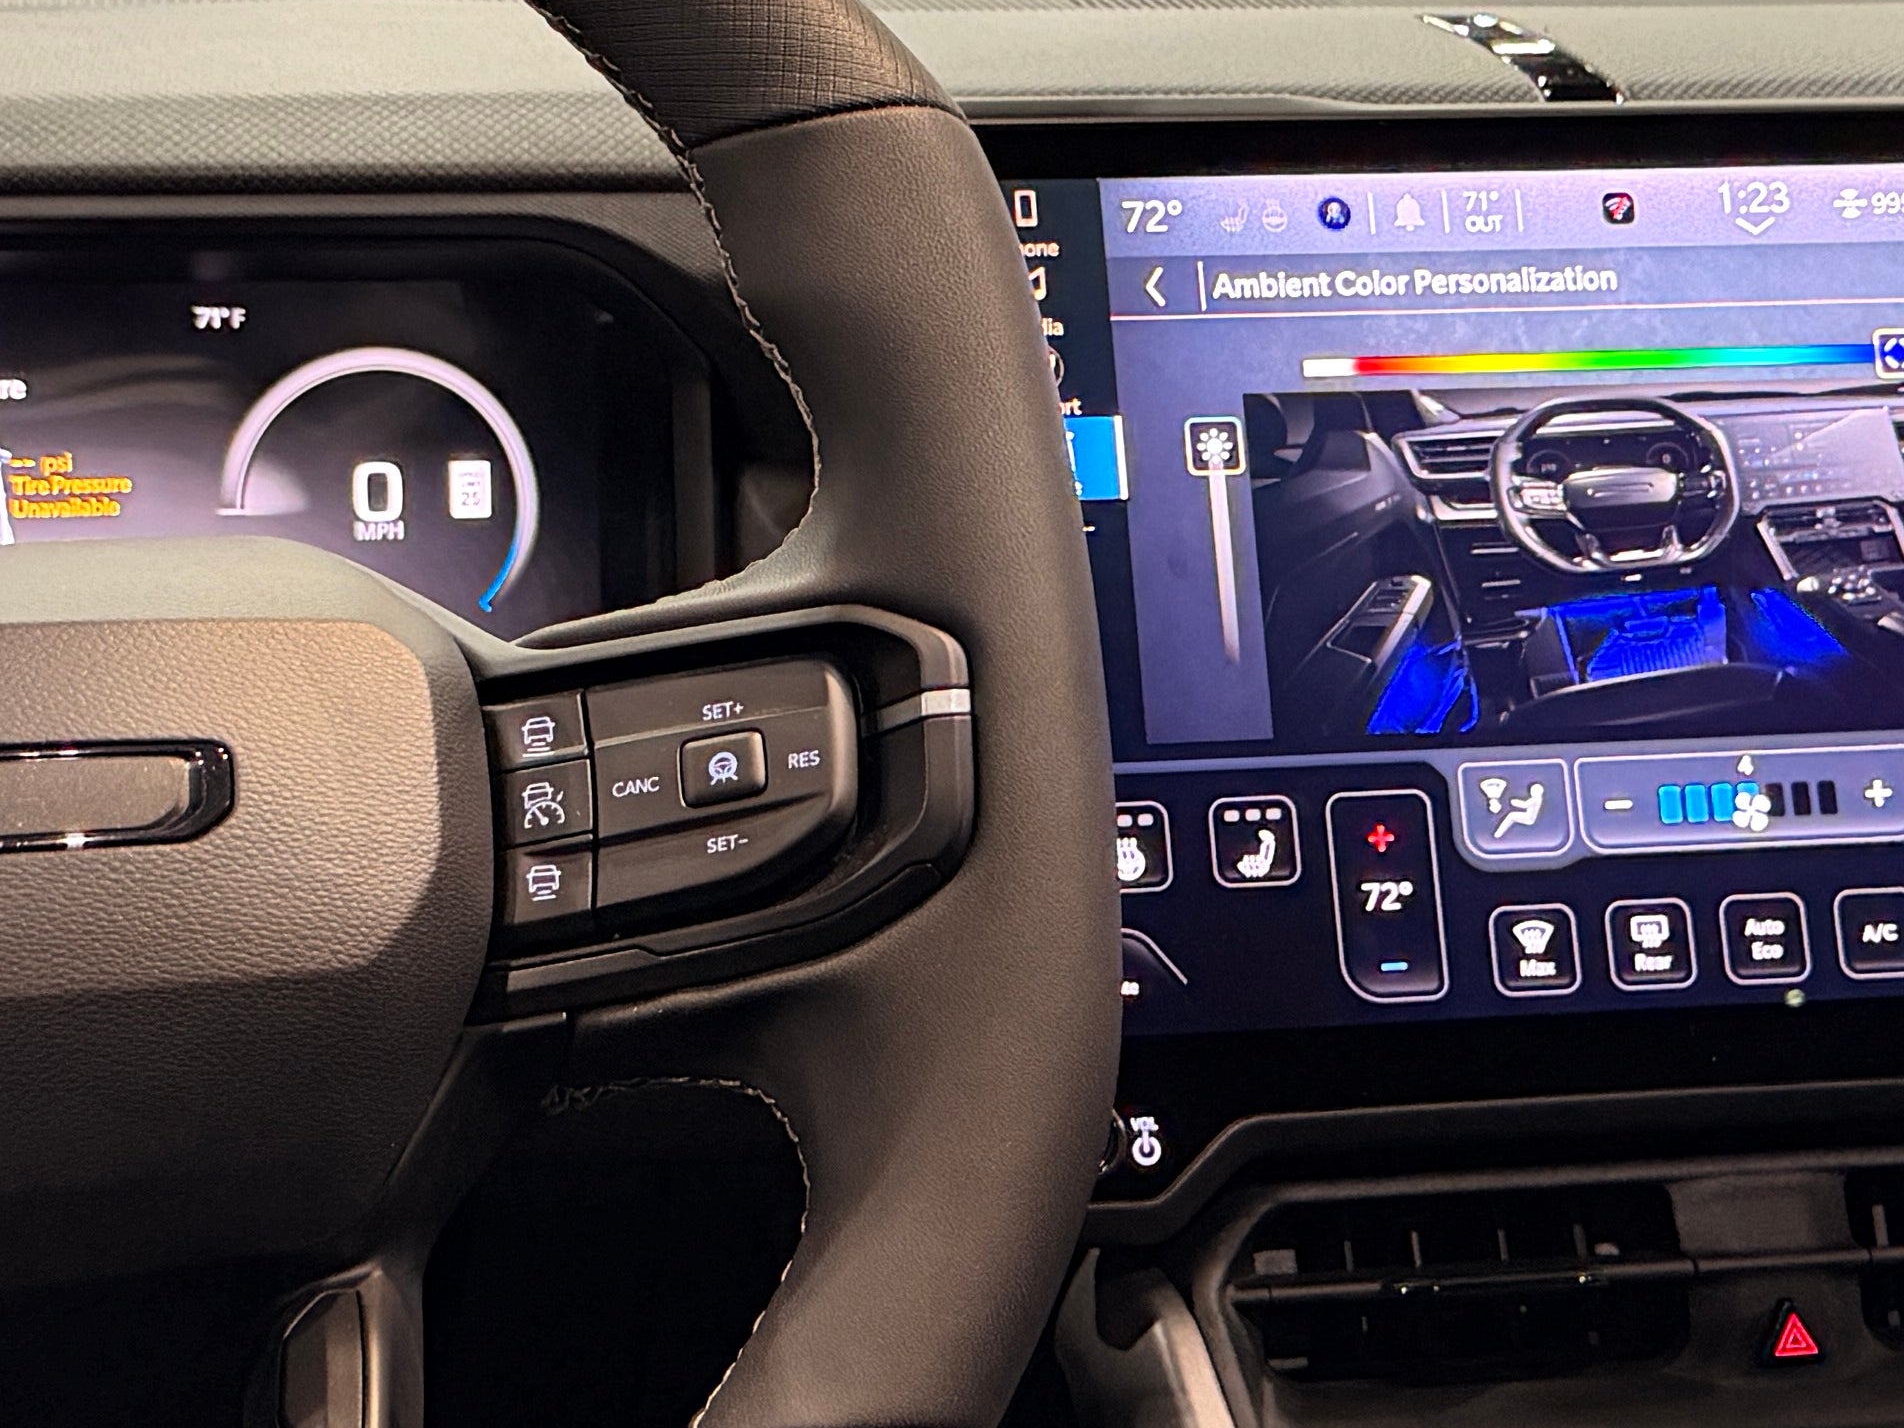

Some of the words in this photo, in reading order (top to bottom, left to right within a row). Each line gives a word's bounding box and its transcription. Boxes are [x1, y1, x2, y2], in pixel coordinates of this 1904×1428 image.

[1463, 191, 1499, 210] 71°
[1718, 181, 1790, 214] 1:23
[1122, 198, 1183, 234] 72°
[1465, 214, 1503, 233] OUT
[1212, 270, 1334, 300] Ambient
[1335, 268, 1409, 296] Color
[1414, 264, 1618, 295] Personalization
[40, 453, 73, 475] psi
[9, 475, 51, 496] Tire
[51, 475, 133, 495] Pressure
[353, 461, 403, 522] 0
[10, 497, 121, 519] Unavailable
[354, 521, 405, 541] MPH
[701, 701, 745, 722] SET+
[787, 751, 821, 770] RES
[612, 776, 660, 798] CANC
[1360, 880, 1414, 913] 72°
[1744, 917, 1786, 938] Auto
[1862, 923, 1899, 944] A/C
[1751, 941, 1785, 961] Eco
[1519, 959, 1557, 978] Max
[1634, 952, 1674, 972] Rear
